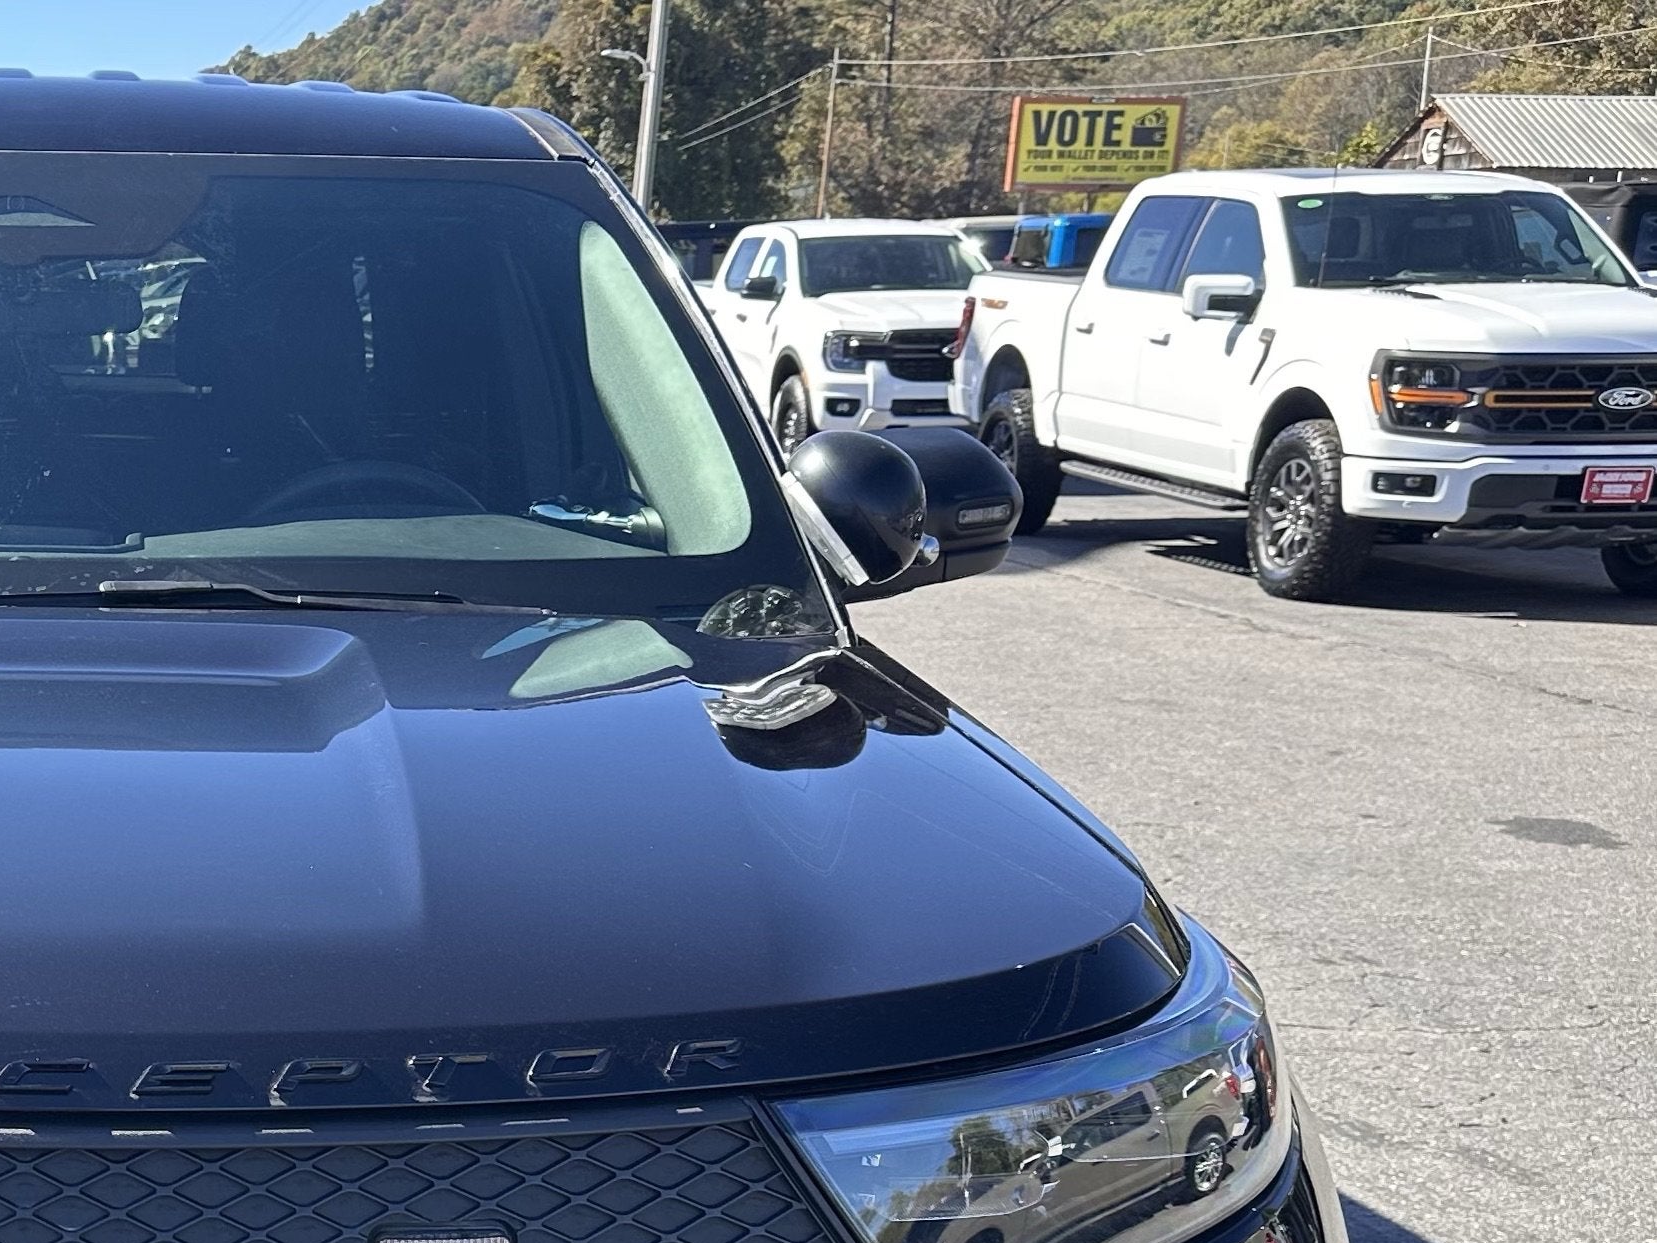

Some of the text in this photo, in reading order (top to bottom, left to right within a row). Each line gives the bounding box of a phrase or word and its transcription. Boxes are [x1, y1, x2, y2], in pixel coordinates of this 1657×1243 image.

[1032, 109, 1125, 147] VOTE
[1027, 150, 1053, 160] YOUR
[1057, 150, 1096, 160] WALLET
[1098, 150, 1140, 160] DEPENDS
